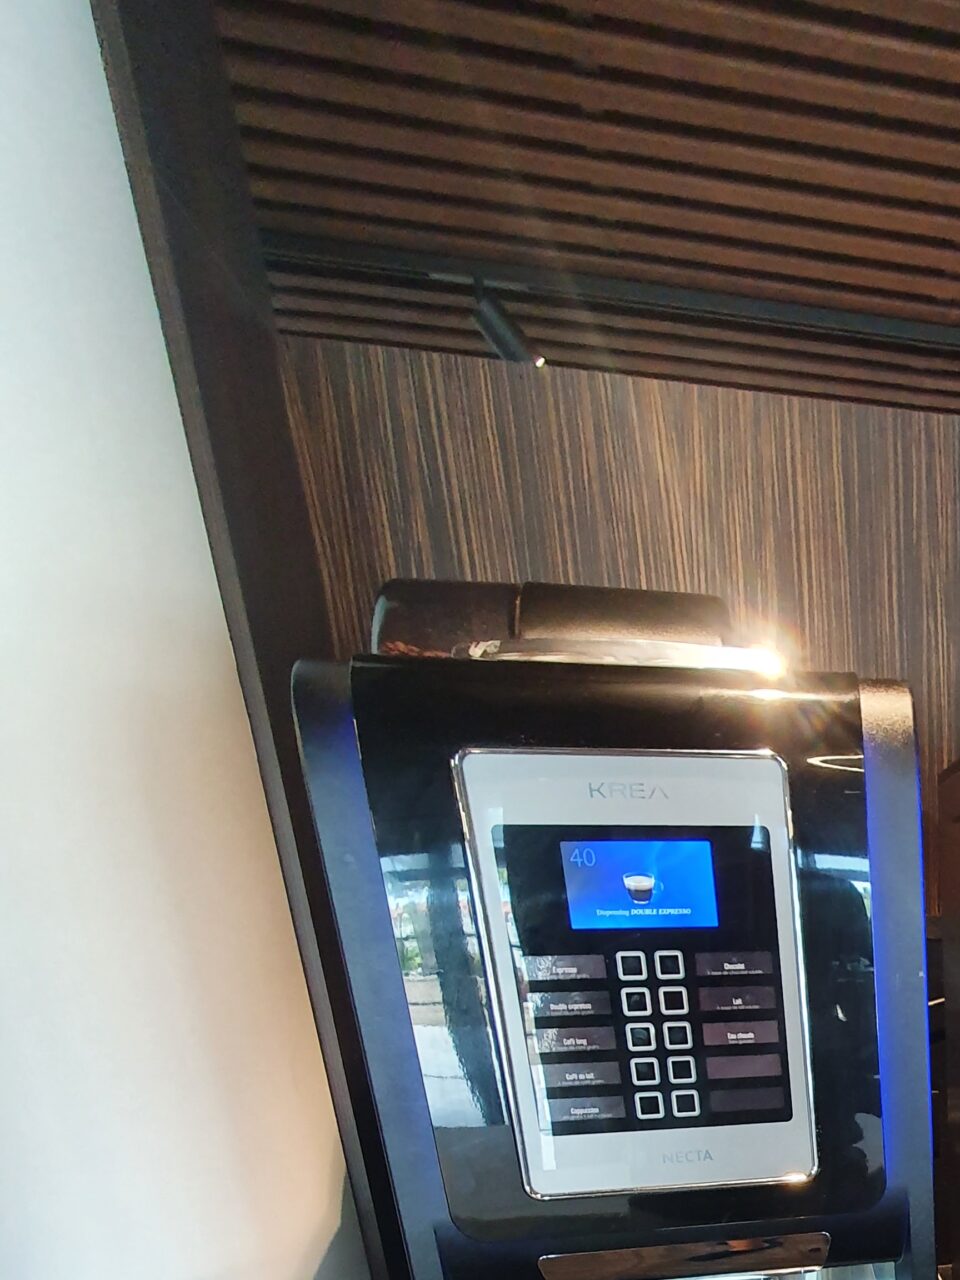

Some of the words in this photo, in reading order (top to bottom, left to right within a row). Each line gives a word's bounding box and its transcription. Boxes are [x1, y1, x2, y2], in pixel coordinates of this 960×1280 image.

[588, 782, 669, 799] KREA
[570, 848, 596, 867] 40
[630, 906, 657, 915] DOUBLE
[662, 1149, 714, 1164] NECTA
